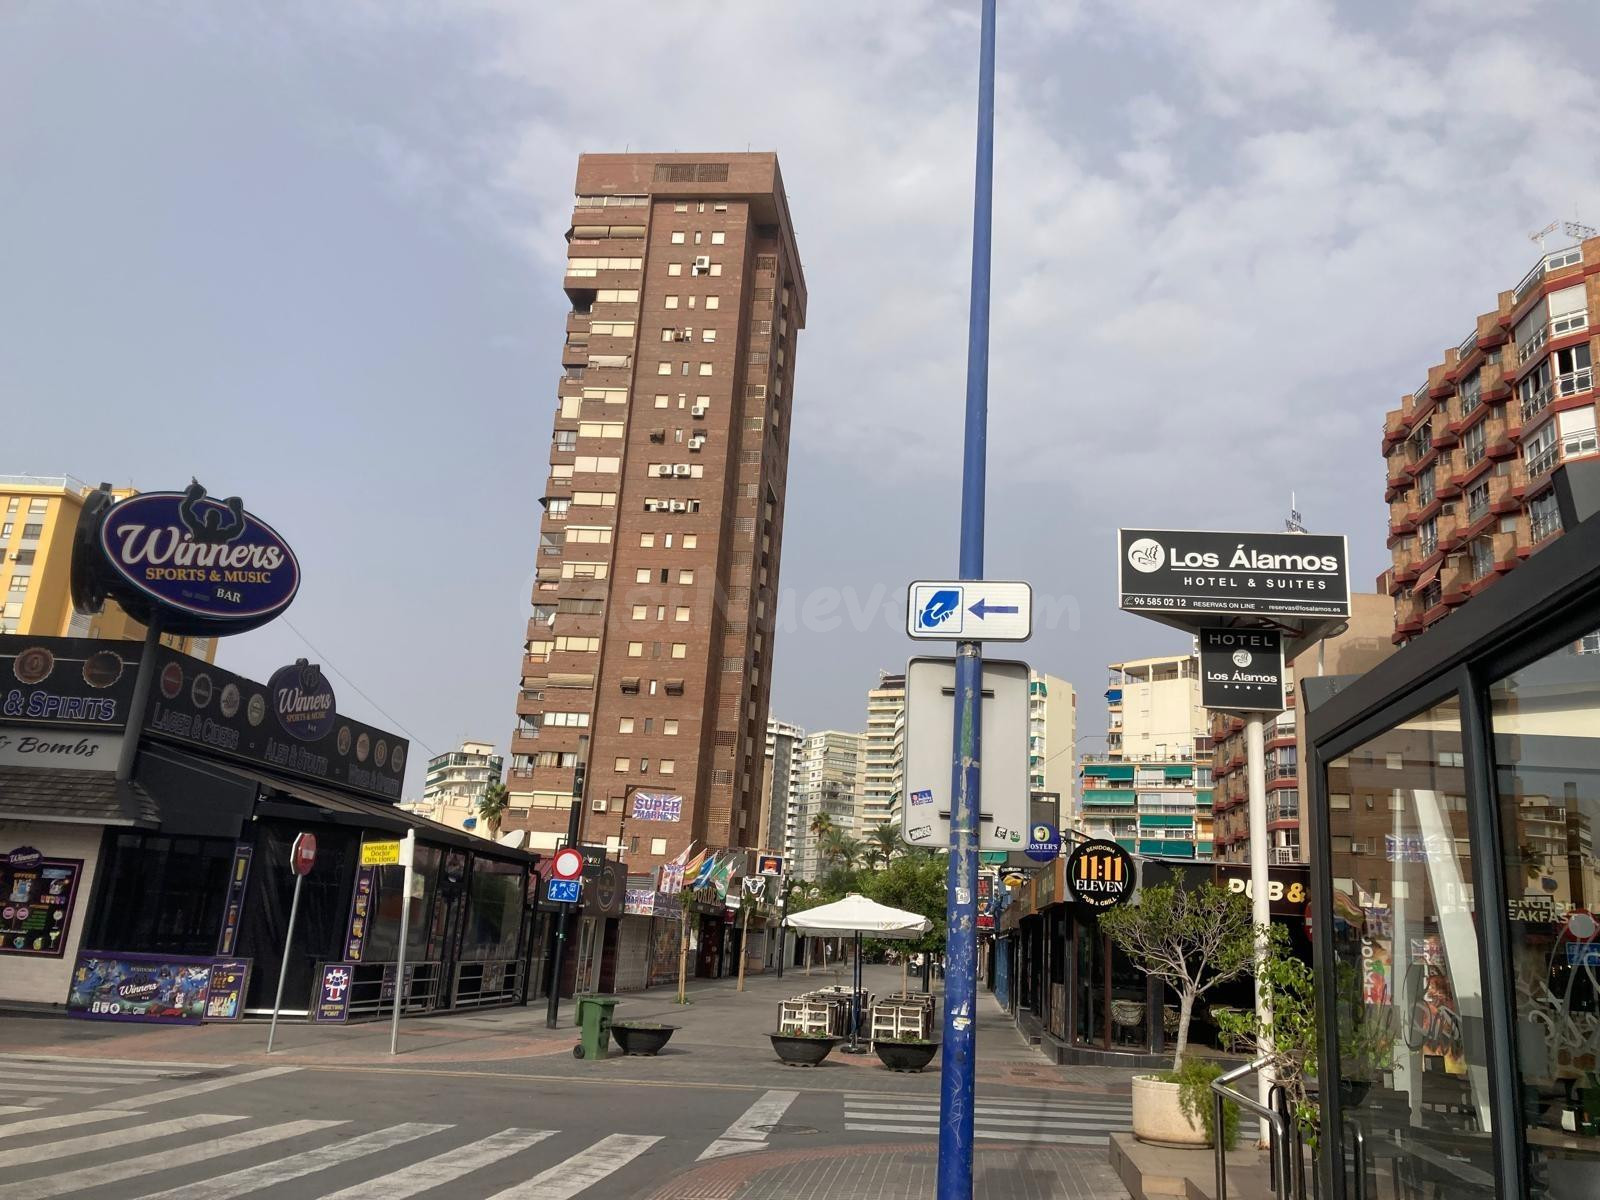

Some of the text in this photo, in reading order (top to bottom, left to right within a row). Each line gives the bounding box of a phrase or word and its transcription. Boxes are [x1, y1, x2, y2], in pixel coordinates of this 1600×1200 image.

[116, 524, 285, 570] Winners
[1170, 543, 1338, 572] Los Álamos
[145, 567, 272, 584] SPORTS & MUSIC
[1184, 576, 1327, 590] HOTEL & SUITES
[216, 588, 241, 604] BAR
[1134, 597, 1145, 606] 96
[1146, 597, 1162, 607] 585
[1163, 597, 1175, 607] 02
[1176, 598, 1187, 608] 12
[1193, 601, 1228, 609] RESERVAS
[1240, 602, 1256, 610] LINE
[1268, 604, 1342, 613] reservas@losalamos.es
[1209, 633, 1274, 647] HOTEL
[1207, 670, 1278, 683] Los Álamos
[3, 689, 117, 721] & SPIRITS
[278, 687, 332, 714] Winners
[17, 737, 99, 758] Bombs
[634, 798, 681, 813] SUPER
[636, 811, 678, 820] MARKET
[1086, 845, 1116, 854] BENIDORM
[1079, 854, 1122, 881] 11:11
[1076, 879, 1123, 893] ELEVEN
[1287, 882, 1306, 903] &
[1082, 894, 1095, 905] PUB
[1100, 896, 1117, 906] GRILL
[1508, 909, 1578, 924] EAKFAST
[119, 982, 160, 996] Winners
